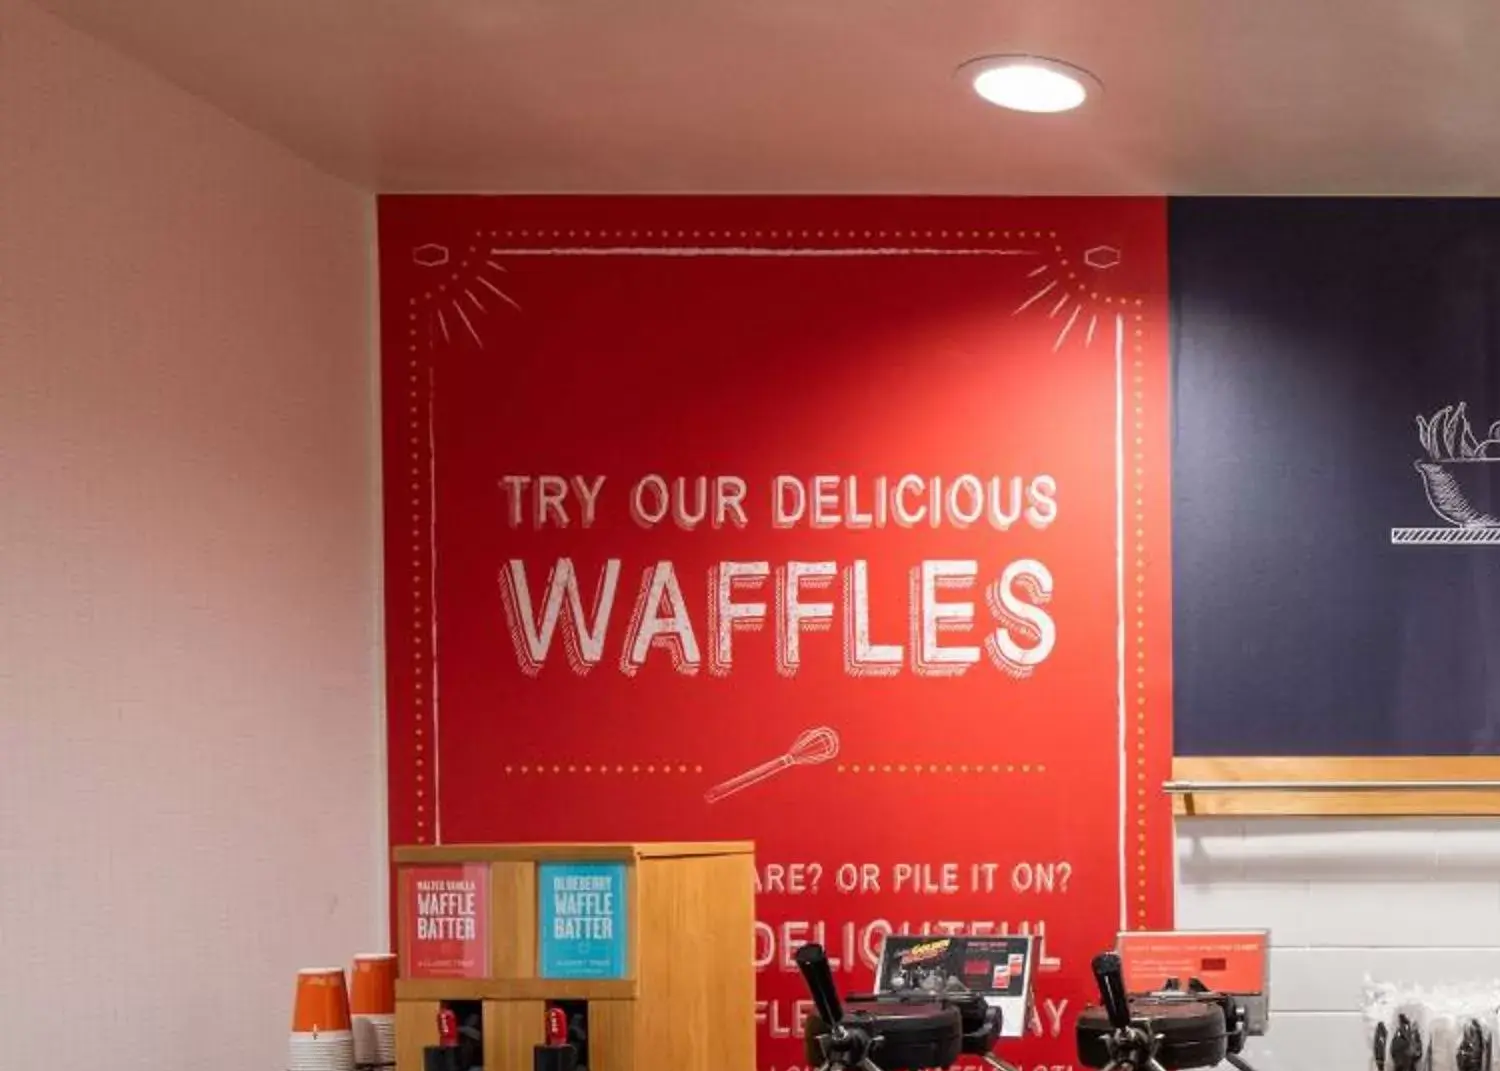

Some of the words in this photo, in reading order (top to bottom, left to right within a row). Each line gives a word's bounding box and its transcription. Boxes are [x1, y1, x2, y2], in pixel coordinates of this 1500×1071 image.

[501, 473, 606, 529] TRY
[630, 473, 748, 530] OUR
[772, 473, 1057, 531] DELICIOUS
[499, 558, 1055, 677] WAFFLES
[835, 863, 881, 893] OR
[892, 863, 960, 893] PILE
[970, 863, 999, 893] IT
[1011, 862, 1073, 893] ON?
[417, 892, 476, 916] WAFFLE
[553, 892, 614, 916] WAFFLE
[417, 917, 476, 941] BATTER
[553, 917, 613, 941] BATTER
